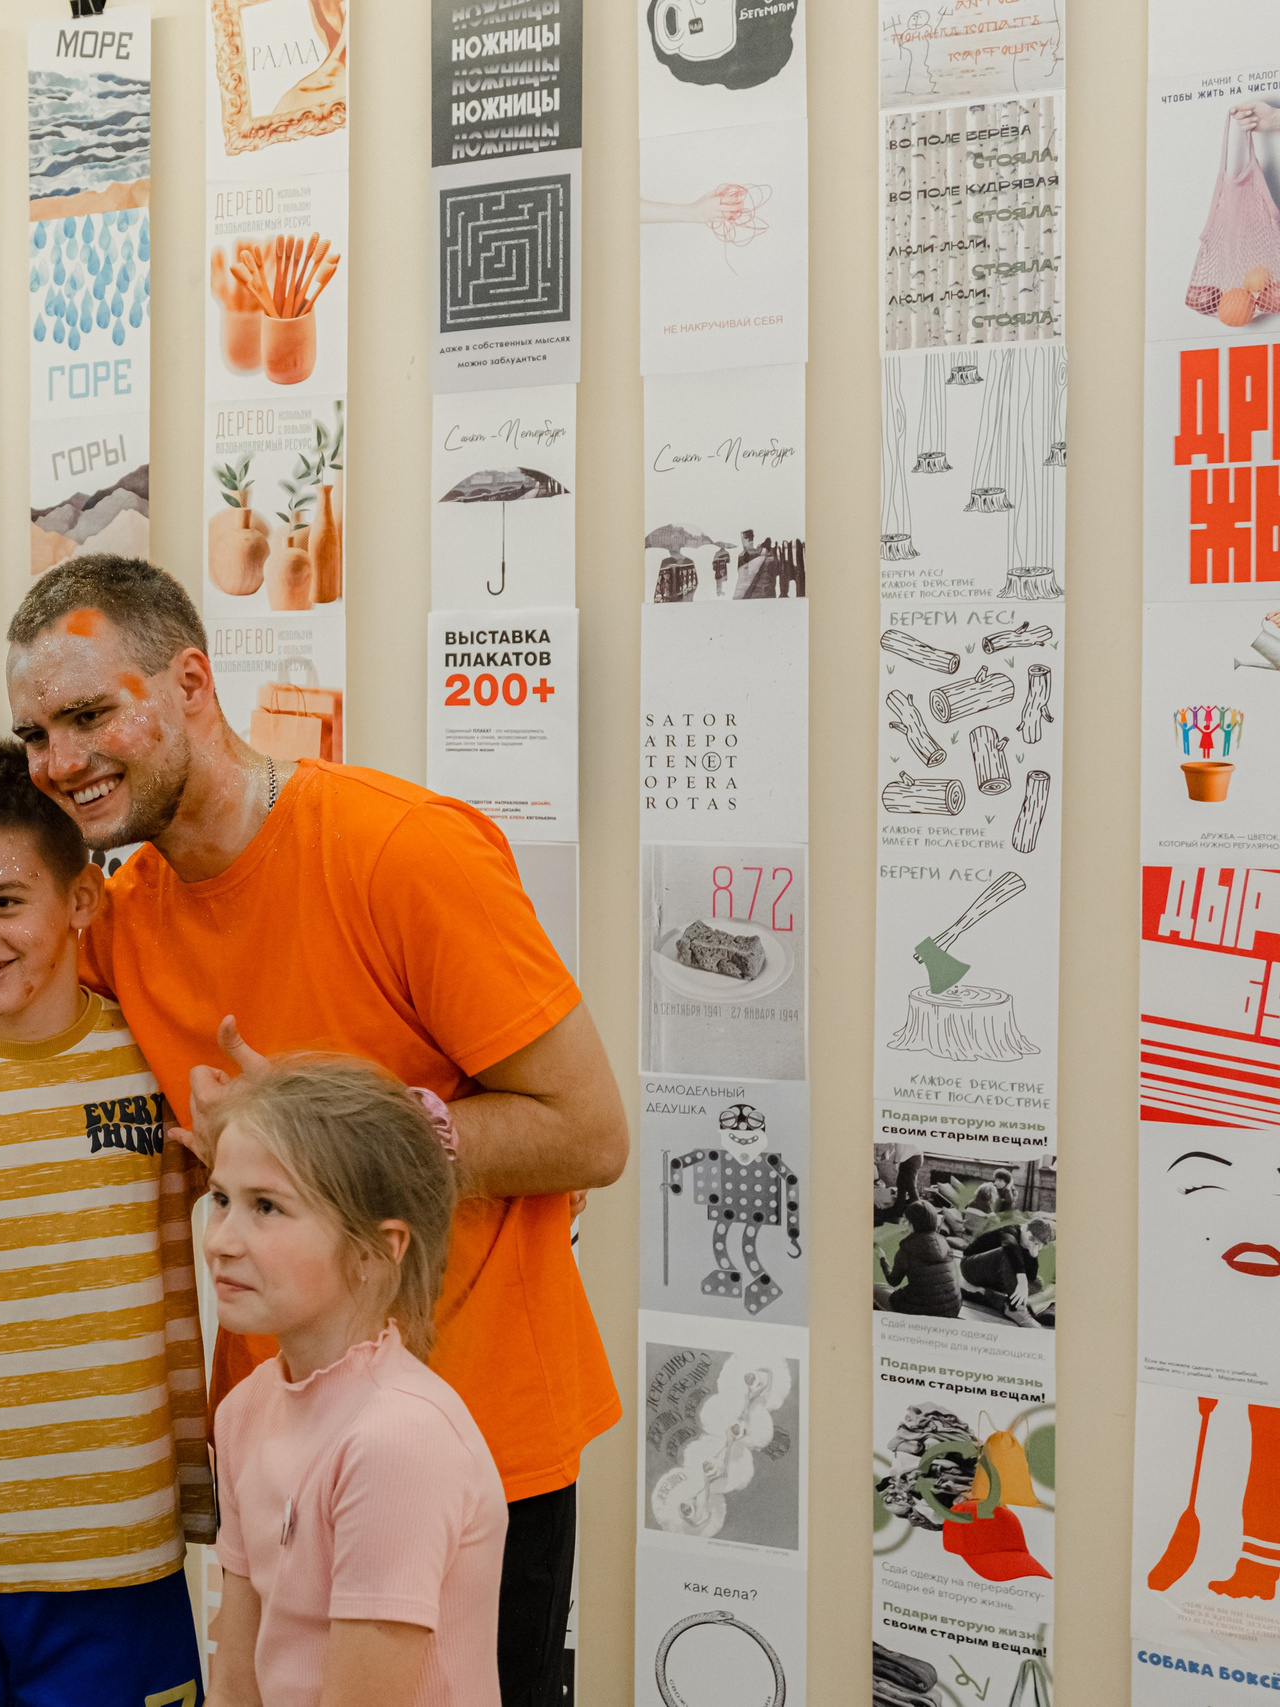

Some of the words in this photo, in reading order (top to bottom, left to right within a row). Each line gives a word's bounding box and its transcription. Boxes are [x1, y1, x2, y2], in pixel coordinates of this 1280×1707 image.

[739, 1, 795, 20] БЕГЕМОТОМ
[56, 29, 133, 60] МОРЕ
[451, 22, 560, 62] НОЖНИЦЫ
[252, 38, 320, 71] РАМА
[1161, 93, 1192, 104] ЧТОБЫ
[1198, 88, 1224, 99] ЖИТЬ
[1230, 86, 1242, 95] НА
[1248, 81, 1280, 92] ЧИСТО
[1201, 76, 1231, 87] НАЧНИ
[451, 87, 560, 126] НОЖНИЦЫ
[889, 138, 911, 150] ВО
[917, 132, 960, 147] ПОЛЕ
[966, 124, 1031, 141] БЕРЁЗА
[972, 147, 1058, 169] СТОЯЛА,
[889, 191, 911, 202] ВО
[917, 185, 960, 199] ПОЛЕ
[966, 175, 1059, 195] КУДРЯВАЯ
[215, 188, 274, 221] ДЕРЕВО
[888, 244, 934, 257] ЛЮЛИ
[888, 292, 934, 306] ЛЮЛИ
[664, 325, 677, 334] НЕ
[680, 317, 751, 333] НАКРУЧИВАЙ
[754, 315, 783, 326] СЕБЯ
[439, 345, 463, 354] даже
[472, 338, 532, 350] собственных
[535, 335, 571, 345] мыслях
[457, 359, 488, 368] можно
[490, 354, 547, 366] заблудиться
[48, 358, 132, 401] ГОРЕ
[1174, 343, 1280, 466] ДР
[216, 409, 274, 439] ДЕРЕВО
[51, 434, 127, 481] ГОРЫ
[919, 568, 944, 578] ЛЕС!
[890, 610, 958, 626] БЕРЕГИ
[967, 610, 1016, 626] ЛЕС!
[214, 628, 274, 657] ДЕРЕВО
[444, 629, 551, 645] ВЫСТАВКА
[444, 651, 552, 667] ПЛАКАТОВ
[444, 672, 555, 707] 200+
[645, 713, 738, 727] SATOR
[645, 734, 738, 748] AREPO
[645, 754, 738, 769] TENET
[645, 776, 738, 790] OPERA
[645, 797, 738, 811] ROTAS
[882, 837, 920, 847] ИМЕЕТ
[925, 838, 1005, 849] ПОСЛЕДСТВИЕ
[928, 827, 986, 837] ДЕЙСТВИЕ
[1159, 840, 1198, 848] КОТОРЫЙ
[1200, 841, 1231, 849] НУЖНО
[1233, 842, 1280, 850] РЕГУЛЯРНО
[880, 865, 941, 881] БЕРЕГИ
[949, 868, 993, 882] ЛЕС!
[712, 866, 793, 932] 872
[661, 1003, 701, 1017] СЕНТЯБРЯ
[704, 1005, 722, 1018] 1941
[731, 1007, 741, 1019] 27
[744, 1008, 776, 1020] ЯНВАРЯ
[779, 1009, 799, 1022] 1944
[645, 1082, 745, 1098] САМОДЕЛЬНЫЙ
[910, 1074, 963, 1089] КАЖДОЕ
[970, 1079, 1045, 1094] ДЕЙСТВИЕ
[646, 1102, 707, 1116] ДЕДУШКА
[893, 1087, 942, 1101] ИМЕЕТ
[948, 1091, 1051, 1110] ПОСЛЕДСТВИЕ
[83, 1091, 164, 1129] EVERY
[881, 1109, 938, 1124] Подари
[940, 1116, 996, 1130] вторую
[999, 1121, 1046, 1131] жизнь
[882, 1126, 927, 1137] своим
[930, 1130, 989, 1143] старым
[992, 1136, 1048, 1147] вещам!
[880, 1317, 906, 1329] Сдай
[908, 1323, 959, 1336] ненужную
[960, 1329, 999, 1342] одежду
[888, 1334, 948, 1349] контейнеры
[950, 1342, 968, 1352] для
[970, 1345, 1047, 1361] нуждающихся.
[880, 1356, 936, 1374] Подари
[939, 1368, 994, 1383] вторую
[997, 1376, 1043, 1388] жизнь
[880, 1373, 926, 1387] своим
[928, 1381, 987, 1395] старым
[990, 1388, 1046, 1403] вещам!
[881, 1561, 908, 1575] Сдай
[910, 1568, 949, 1585] одежду
[951, 1578, 964, 1587] на
[684, 1582, 708, 1594] как
[713, 1587, 758, 1601] дела?
[881, 1578, 920, 1593] подари
[922, 1586, 935, 1596] ей
[938, 1590, 978, 1604] вторую
[883, 1601, 938, 1621] Подари
[940, 1617, 996, 1633] вторую
[998, 1627, 1045, 1642] жизнь
[883, 1618, 928, 1634] своим
[930, 1628, 989, 1647] старым
[991, 1640, 1047, 1658] вещам!
[1137, 1650, 1214, 1677] СОБАКА
